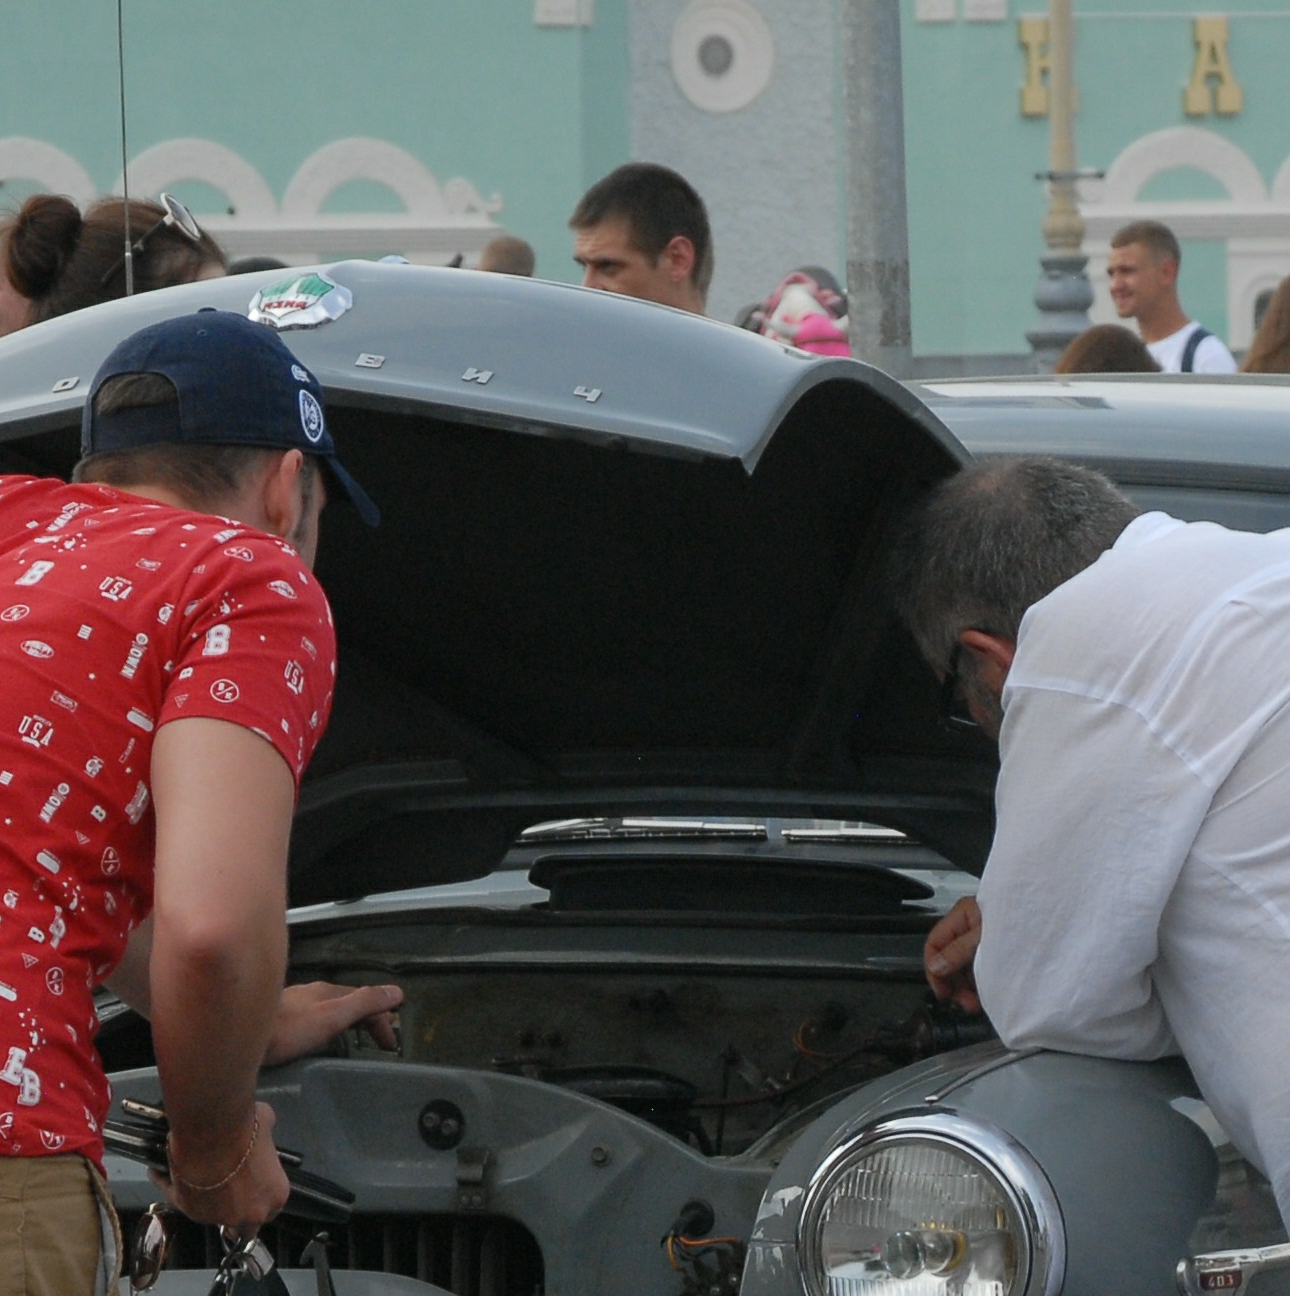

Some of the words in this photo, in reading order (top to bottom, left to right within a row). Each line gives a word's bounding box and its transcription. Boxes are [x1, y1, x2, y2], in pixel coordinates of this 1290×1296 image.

[202, 624, 231, 656] B
[18, 716, 54, 746] USA
[1208, 1274, 1234, 1288] 403
